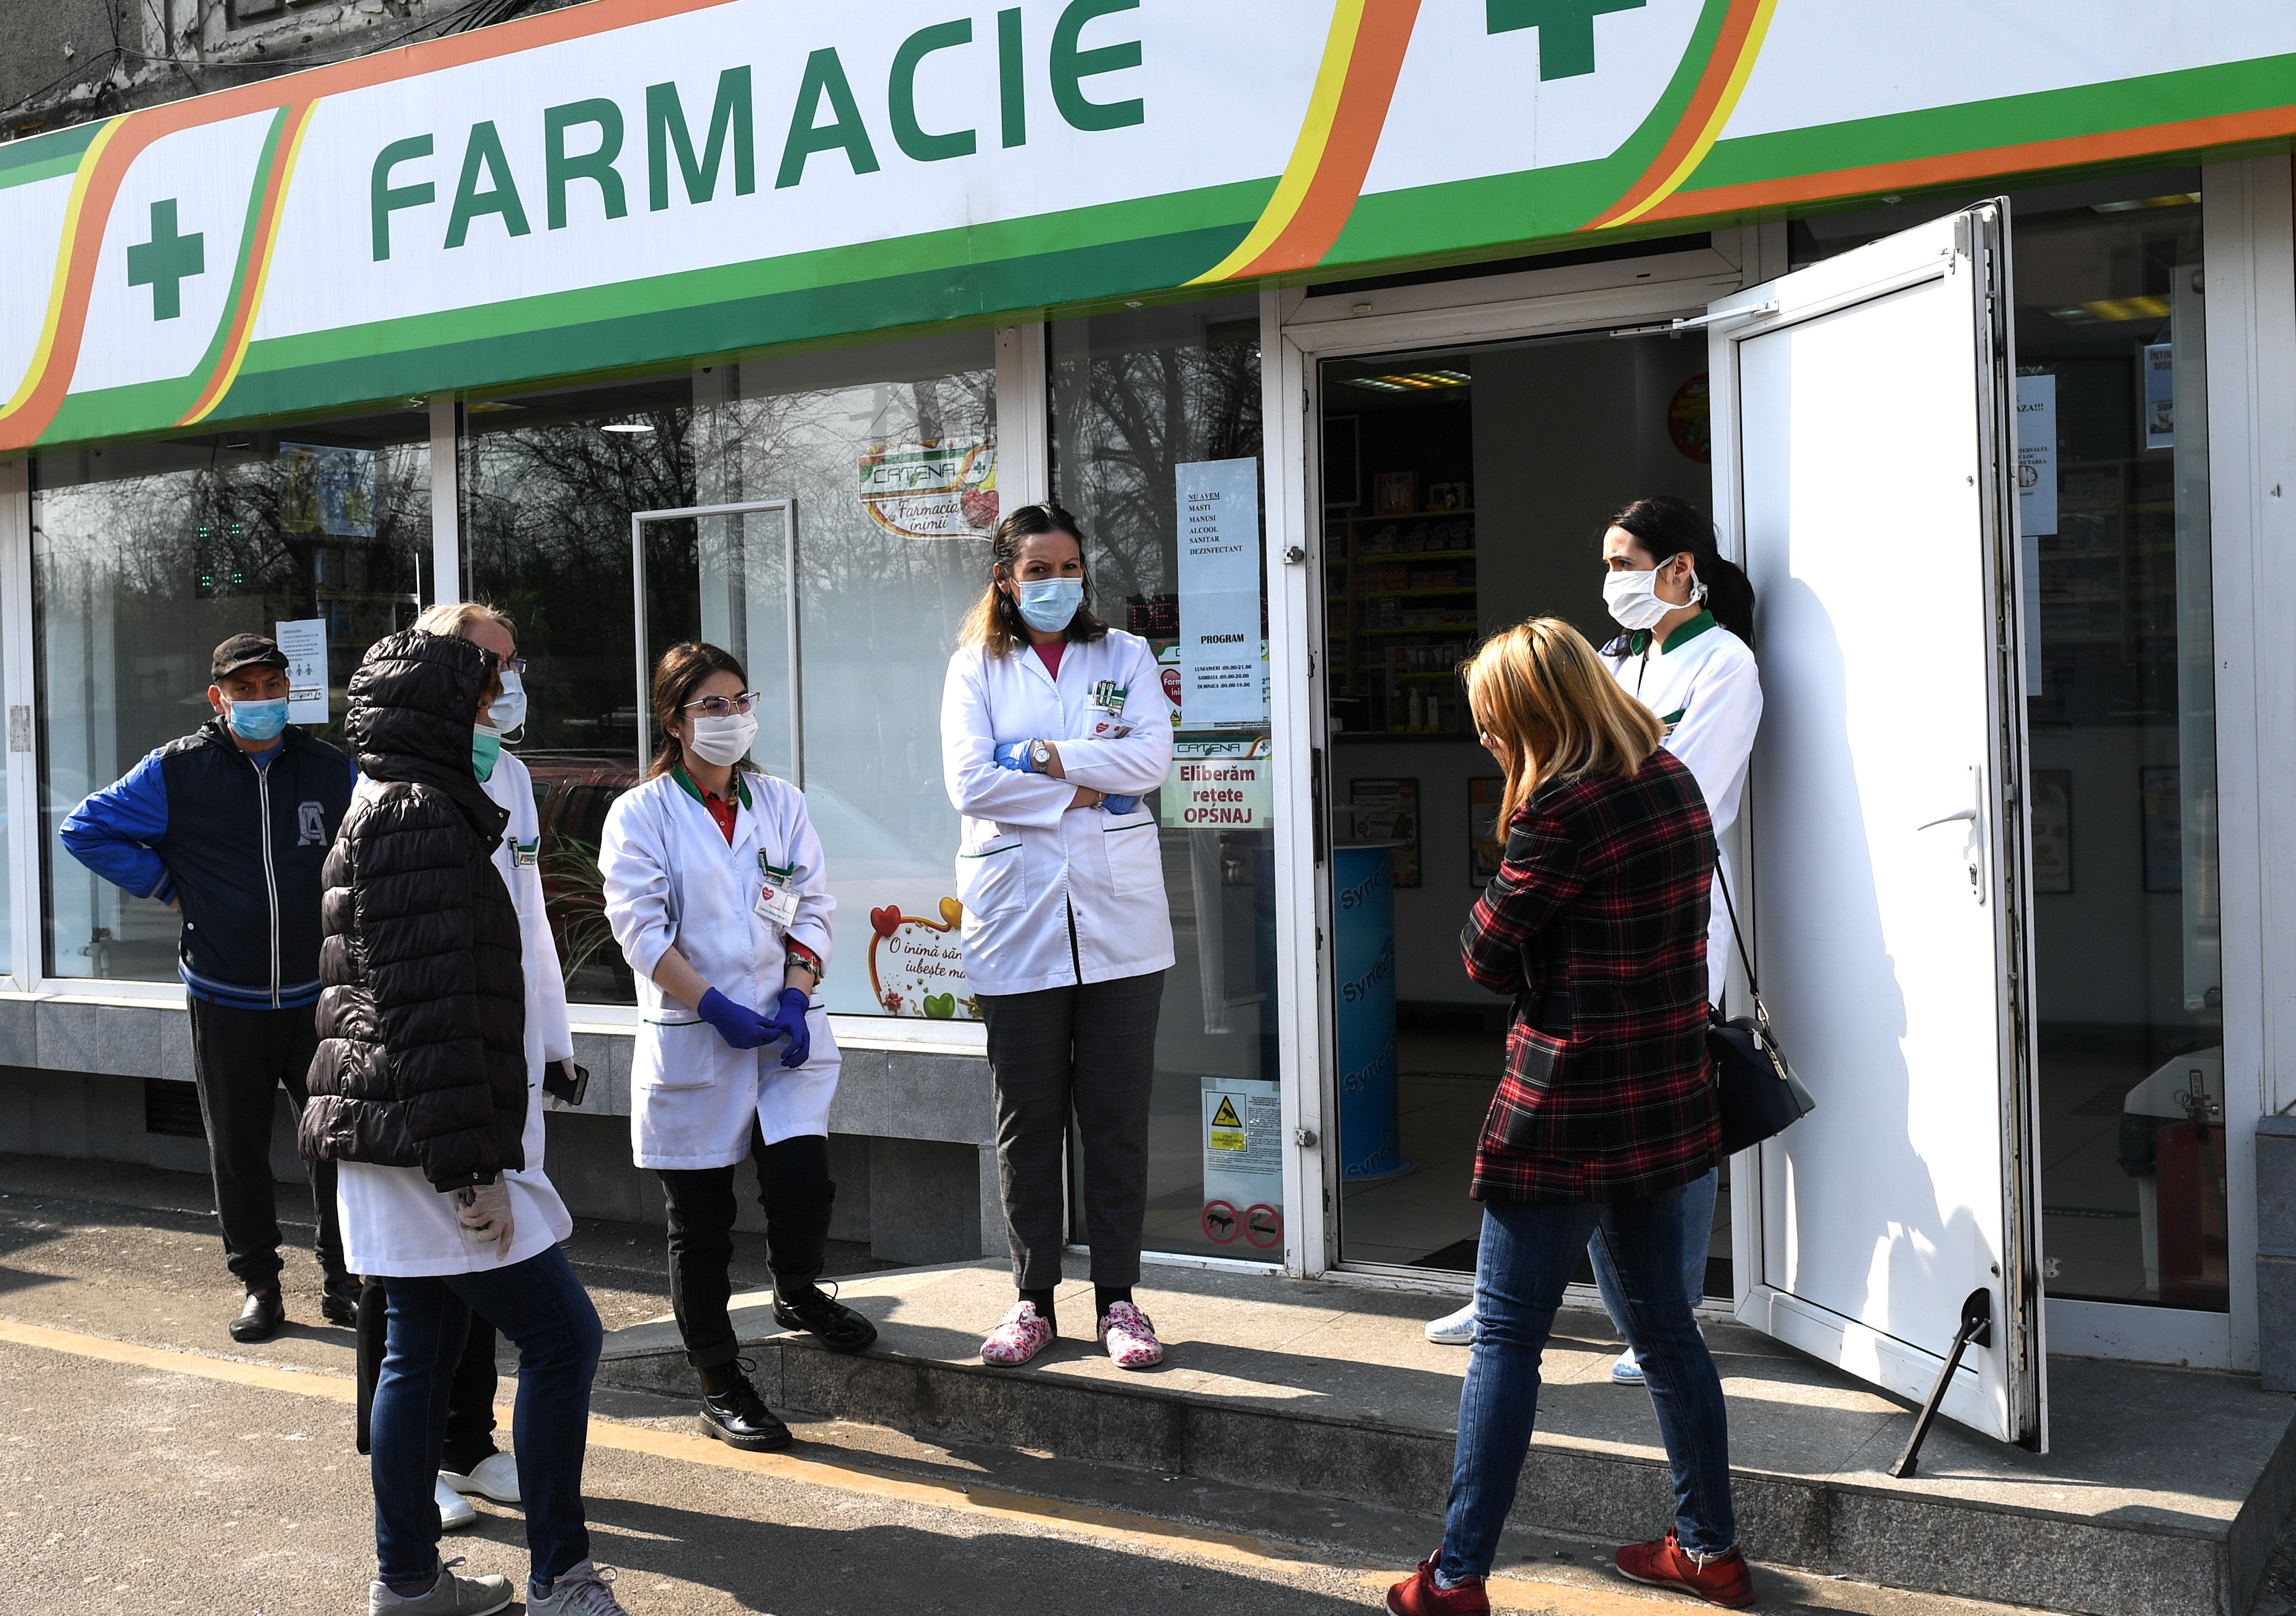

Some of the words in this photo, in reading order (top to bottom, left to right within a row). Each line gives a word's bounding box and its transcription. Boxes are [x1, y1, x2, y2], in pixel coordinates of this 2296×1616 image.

[372, 0, 1144, 261] FARMACIE
[874, 463, 955, 487] CATENA
[1200, 492, 1220, 500] AVEM
[899, 499, 959, 519] Farmacia
[910, 515, 948, 530] inimii
[1189, 515, 1216, 523] MANUSI
[1189, 536, 1220, 544] SANITAR
[1190, 545, 1243, 555] DEZINFECTANT
[1133, 602, 1179, 630] DE
[1200, 633, 1244, 644] PROGRAM
[1177, 743, 1240, 756] CATENA
[1180, 765, 1255, 781] Eliberăm
[1193, 788, 1243, 807] rețete
[890, 937, 901, 953] O
[904, 942, 939, 957] inimă
[905, 958, 946, 978] iubește
